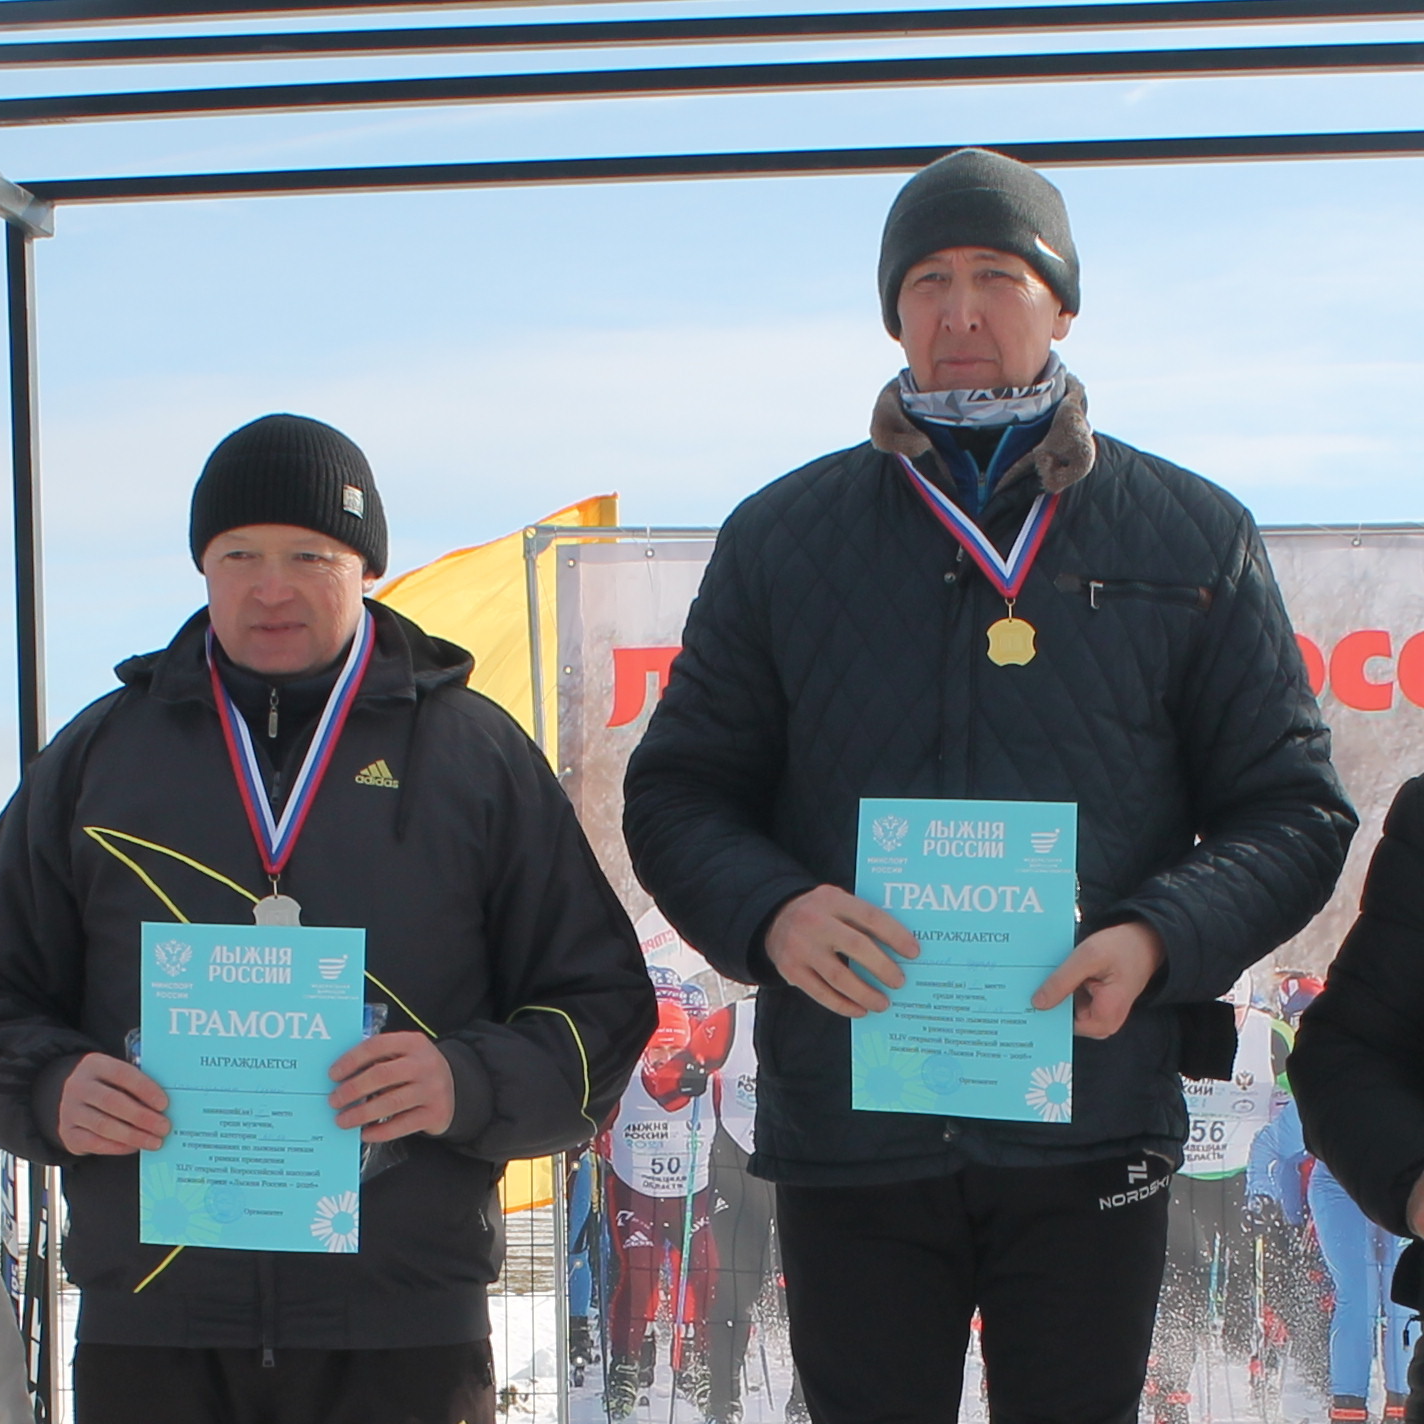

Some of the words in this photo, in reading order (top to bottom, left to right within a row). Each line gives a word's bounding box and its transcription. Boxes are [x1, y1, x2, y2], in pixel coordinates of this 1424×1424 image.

[354, 775, 399, 789] adidas
[925, 820, 1005, 839] ЛЫЖНЯ
[923, 839, 1005, 858] РОССИИ
[882, 882, 1044, 913] ГРАМОТА
[913, 930, 1010, 943] НАГРАЖДАЕТСЯ
[210, 945, 292, 965] ЛЫЖНЯ
[209, 966, 292, 984] РОССИИ
[168, 1008, 331, 1039] ГРАМОТА
[200, 1057, 297, 1070] НАГРАЖДАЕТСЯ
[624, 1132, 669, 1140] РОССИИ
[1191, 1120, 1225, 1142] 56
[651, 1157, 681, 1174] 50
[1186, 1152, 1224, 1161] БЛАСТЬ
[1099, 1174, 1170, 1211] NORDSKI
